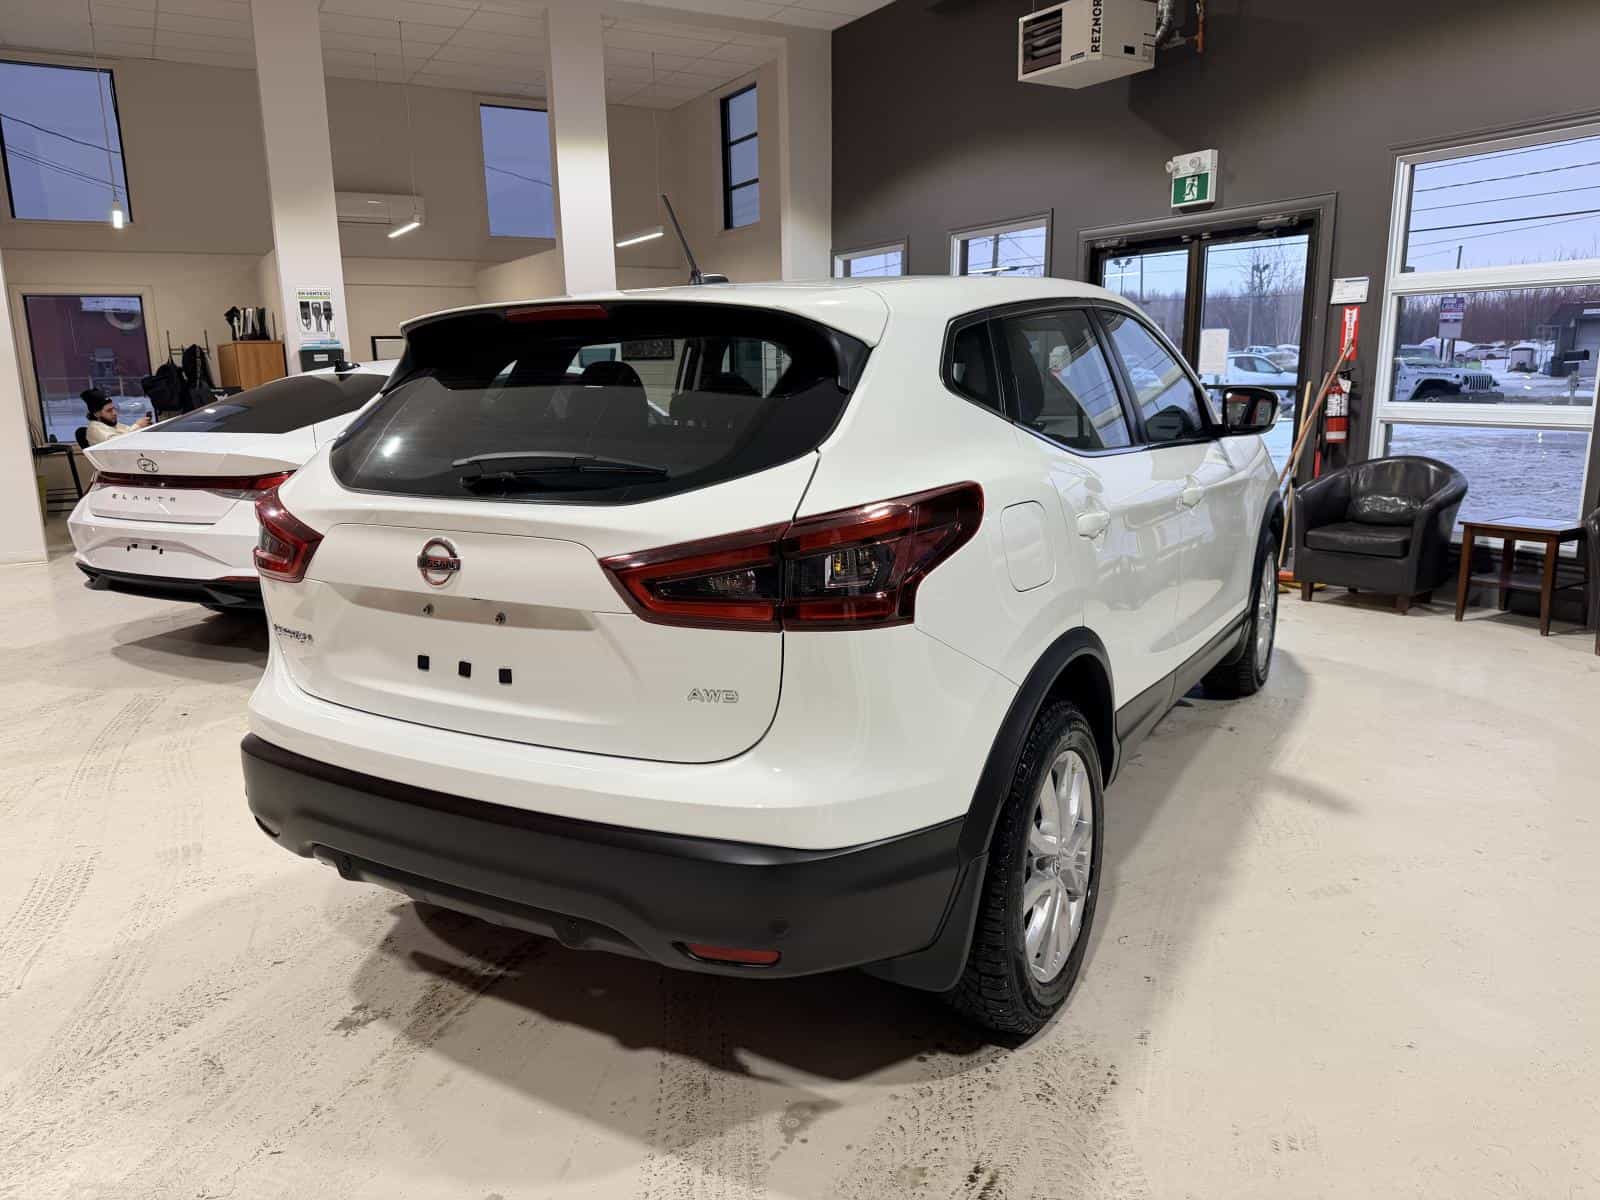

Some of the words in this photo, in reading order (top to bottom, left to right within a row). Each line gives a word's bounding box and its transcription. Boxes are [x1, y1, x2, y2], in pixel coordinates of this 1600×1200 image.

[1091, 0, 1103, 53] REZNOR
[419, 558, 459, 571] NISSAN
[687, 687, 739, 704] AWD
